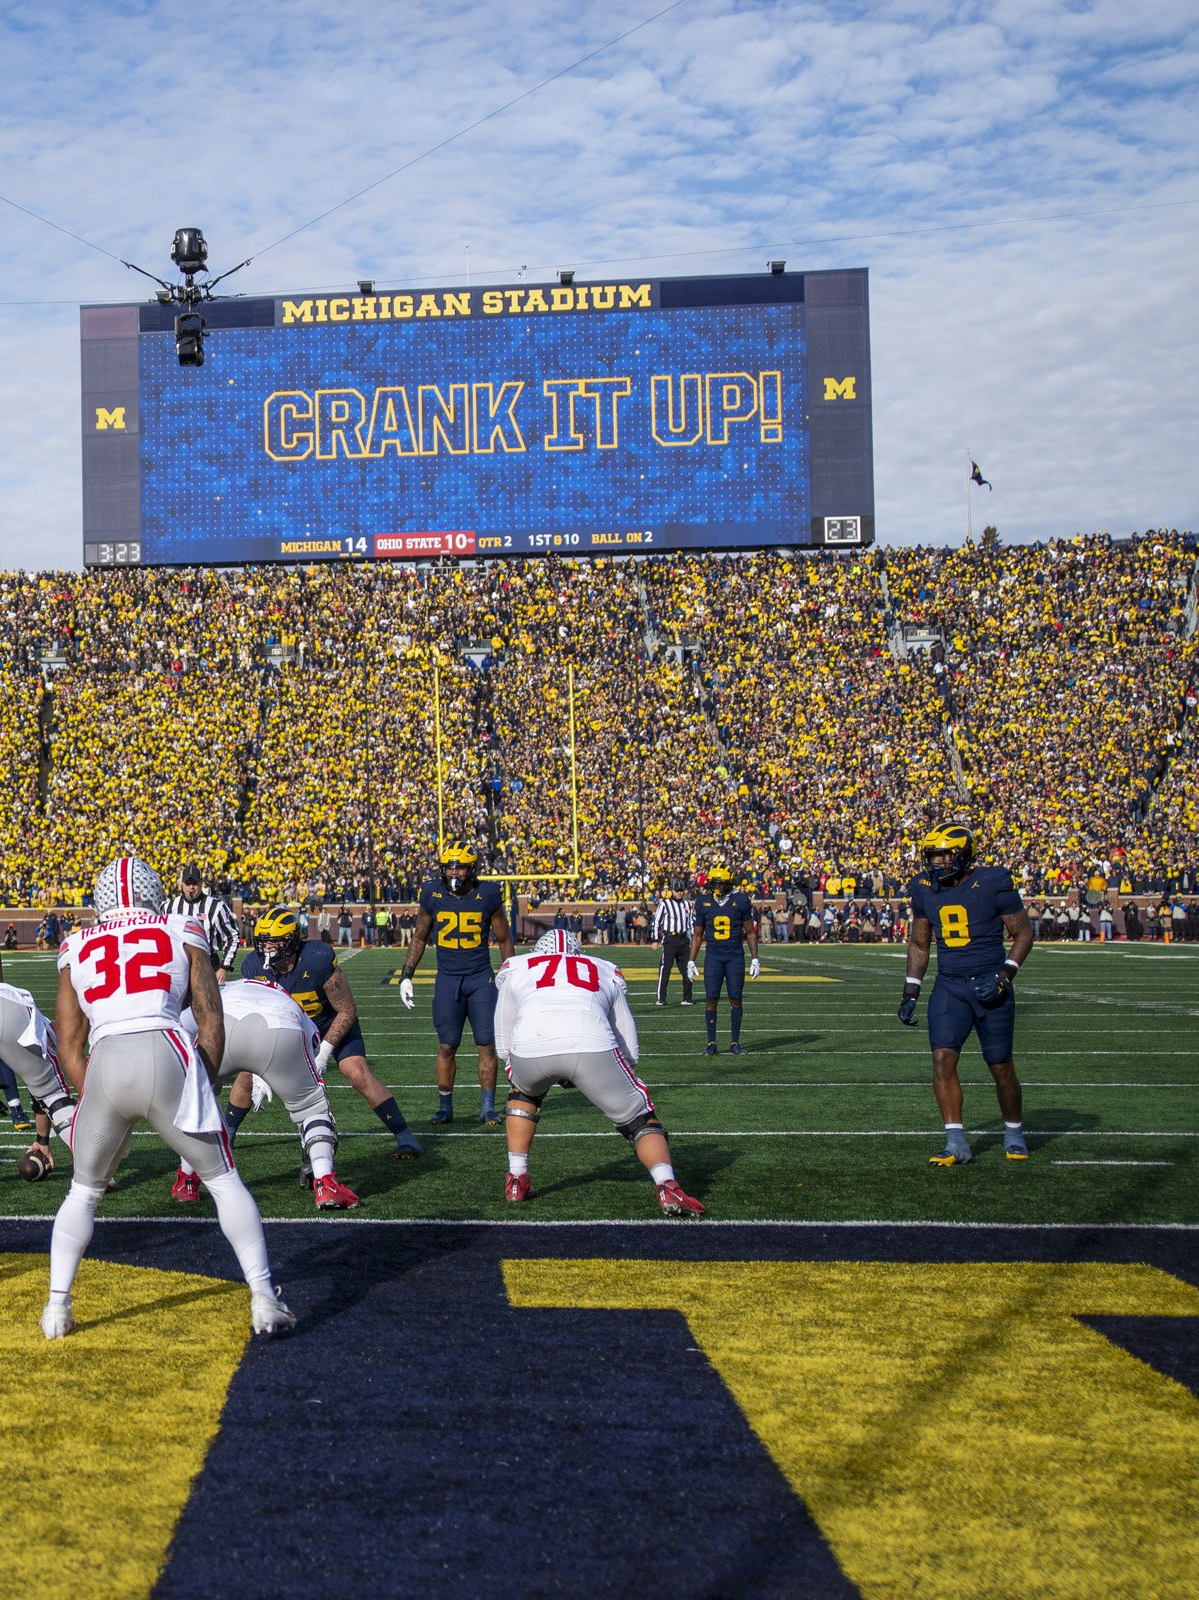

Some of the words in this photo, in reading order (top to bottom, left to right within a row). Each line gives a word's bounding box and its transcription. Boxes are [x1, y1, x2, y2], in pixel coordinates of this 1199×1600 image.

[282, 292, 471, 324] MICHIGAN
[482, 284, 652, 314] STADIUM
[824, 377, 856, 400] M
[95, 407, 126, 429] M
[264, 381, 527, 461] CRANK
[543, 376, 631, 451] IT
[650, 370, 782, 446] UP!
[528, 533, 552, 546] 1ST
[564, 533, 580, 545] 10
[591, 533, 623, 545] BALL
[626, 532, 643, 543] ON
[644, 531, 653, 543] 2
[828, 520, 857, 539] 23
[101, 543, 141, 562] 3:23
[280, 540, 342, 553] MICHIGAN
[345, 536, 368, 552] 14
[377, 538, 403, 550] OHIO
[406, 537, 442, 550] STATE
[445, 533, 467, 549] 10
[478, 537, 502, 548] QTR
[504, 535, 513, 547] 2
[436, 911, 483, 949] 25
[713, 915, 731, 940] 9
[939, 904, 971, 947] 8
[78, 927, 174, 1004] 32
[527, 954, 600, 992] 70
